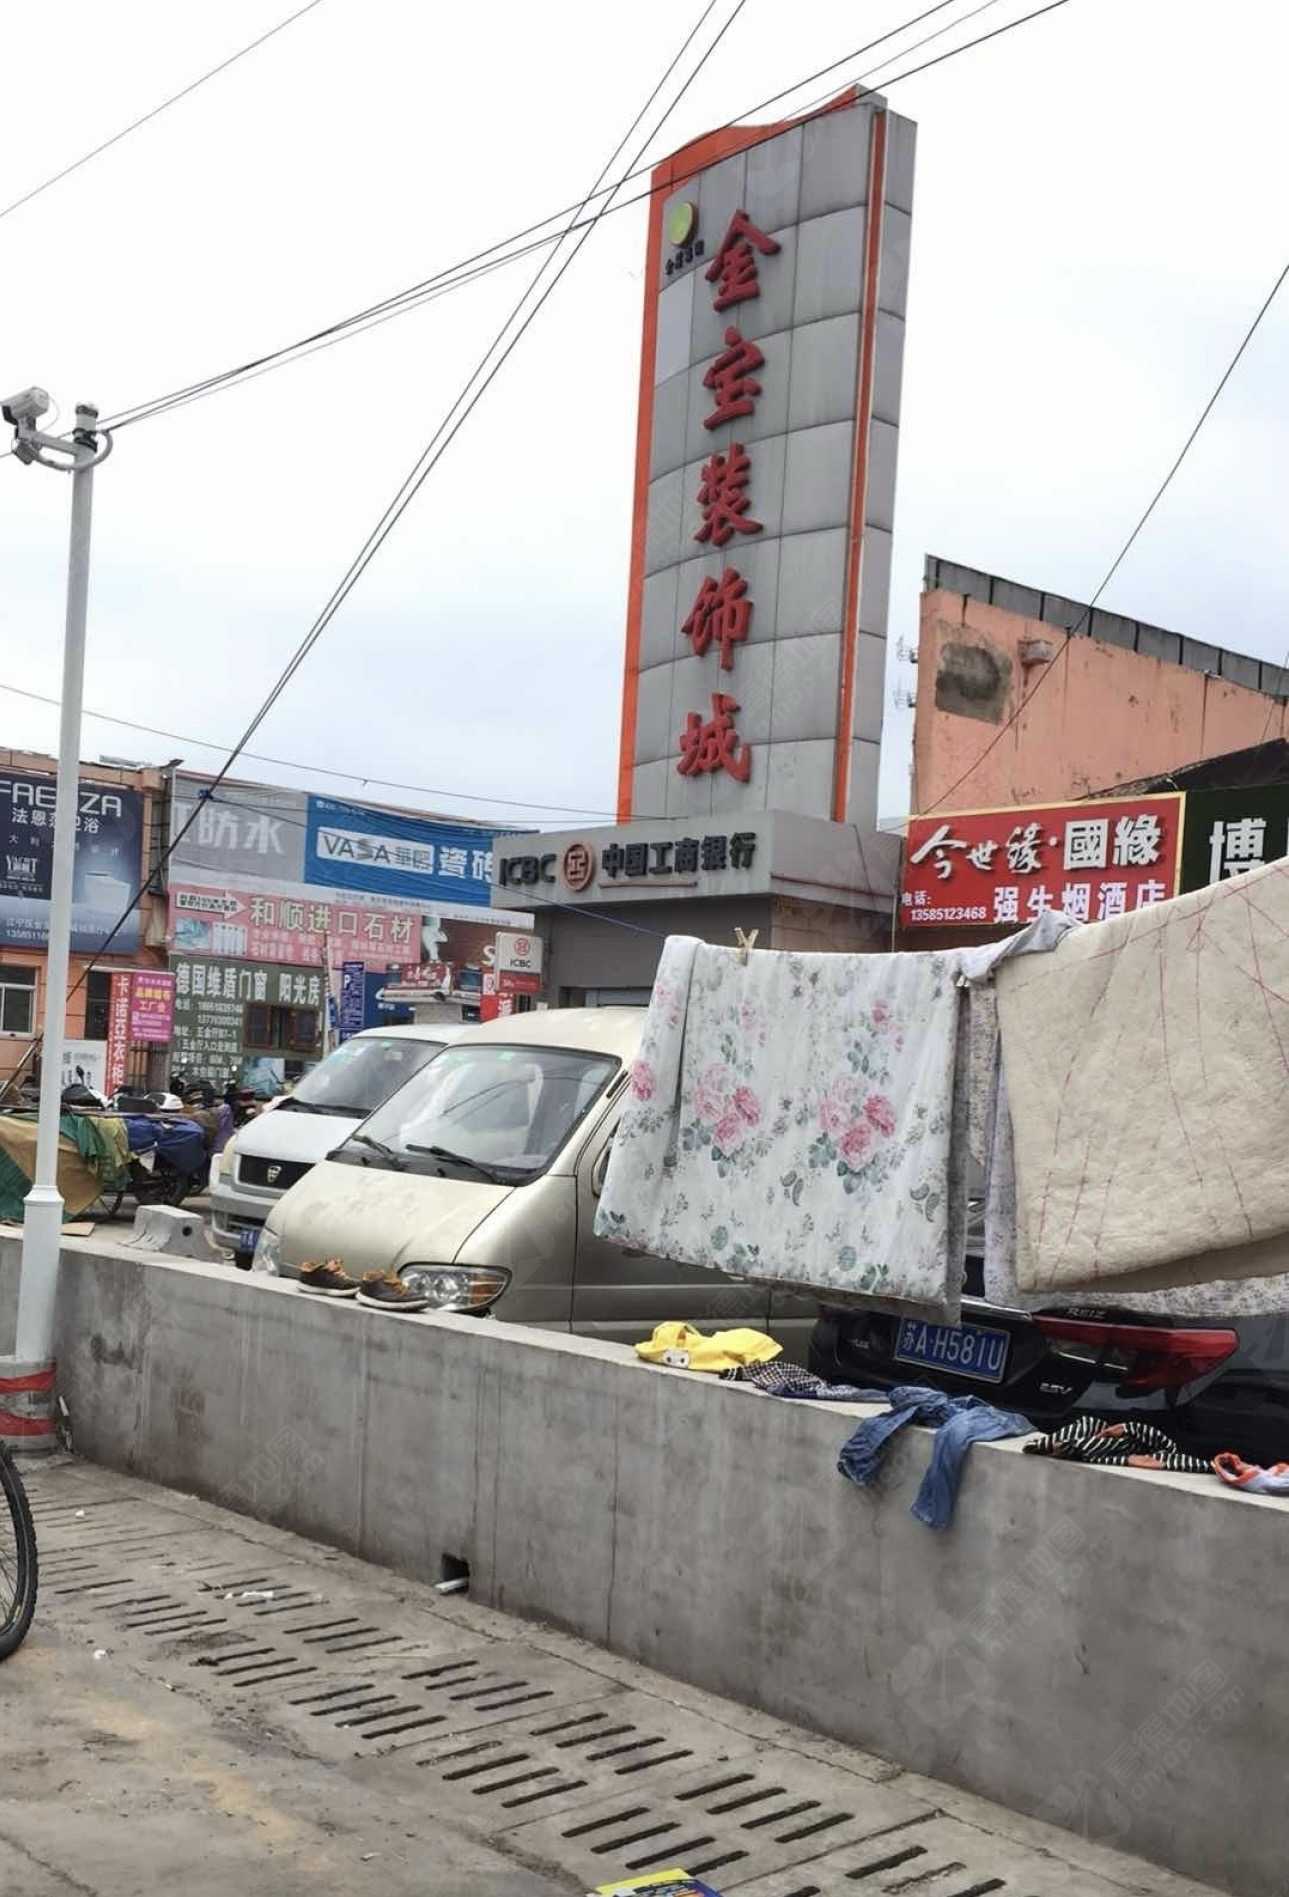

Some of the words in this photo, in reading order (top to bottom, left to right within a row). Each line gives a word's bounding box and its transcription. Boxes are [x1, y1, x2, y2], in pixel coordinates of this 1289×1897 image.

[676, 208, 782, 784] 金宝装饰城
[500, 853, 557, 888] ICBC
[601, 831, 757, 878] 中国工商银行
[250, 896, 413, 944] 和顺进口石材
[911, 906, 987, 921] 13585123468
[510, 958, 532, 968] ICBC
